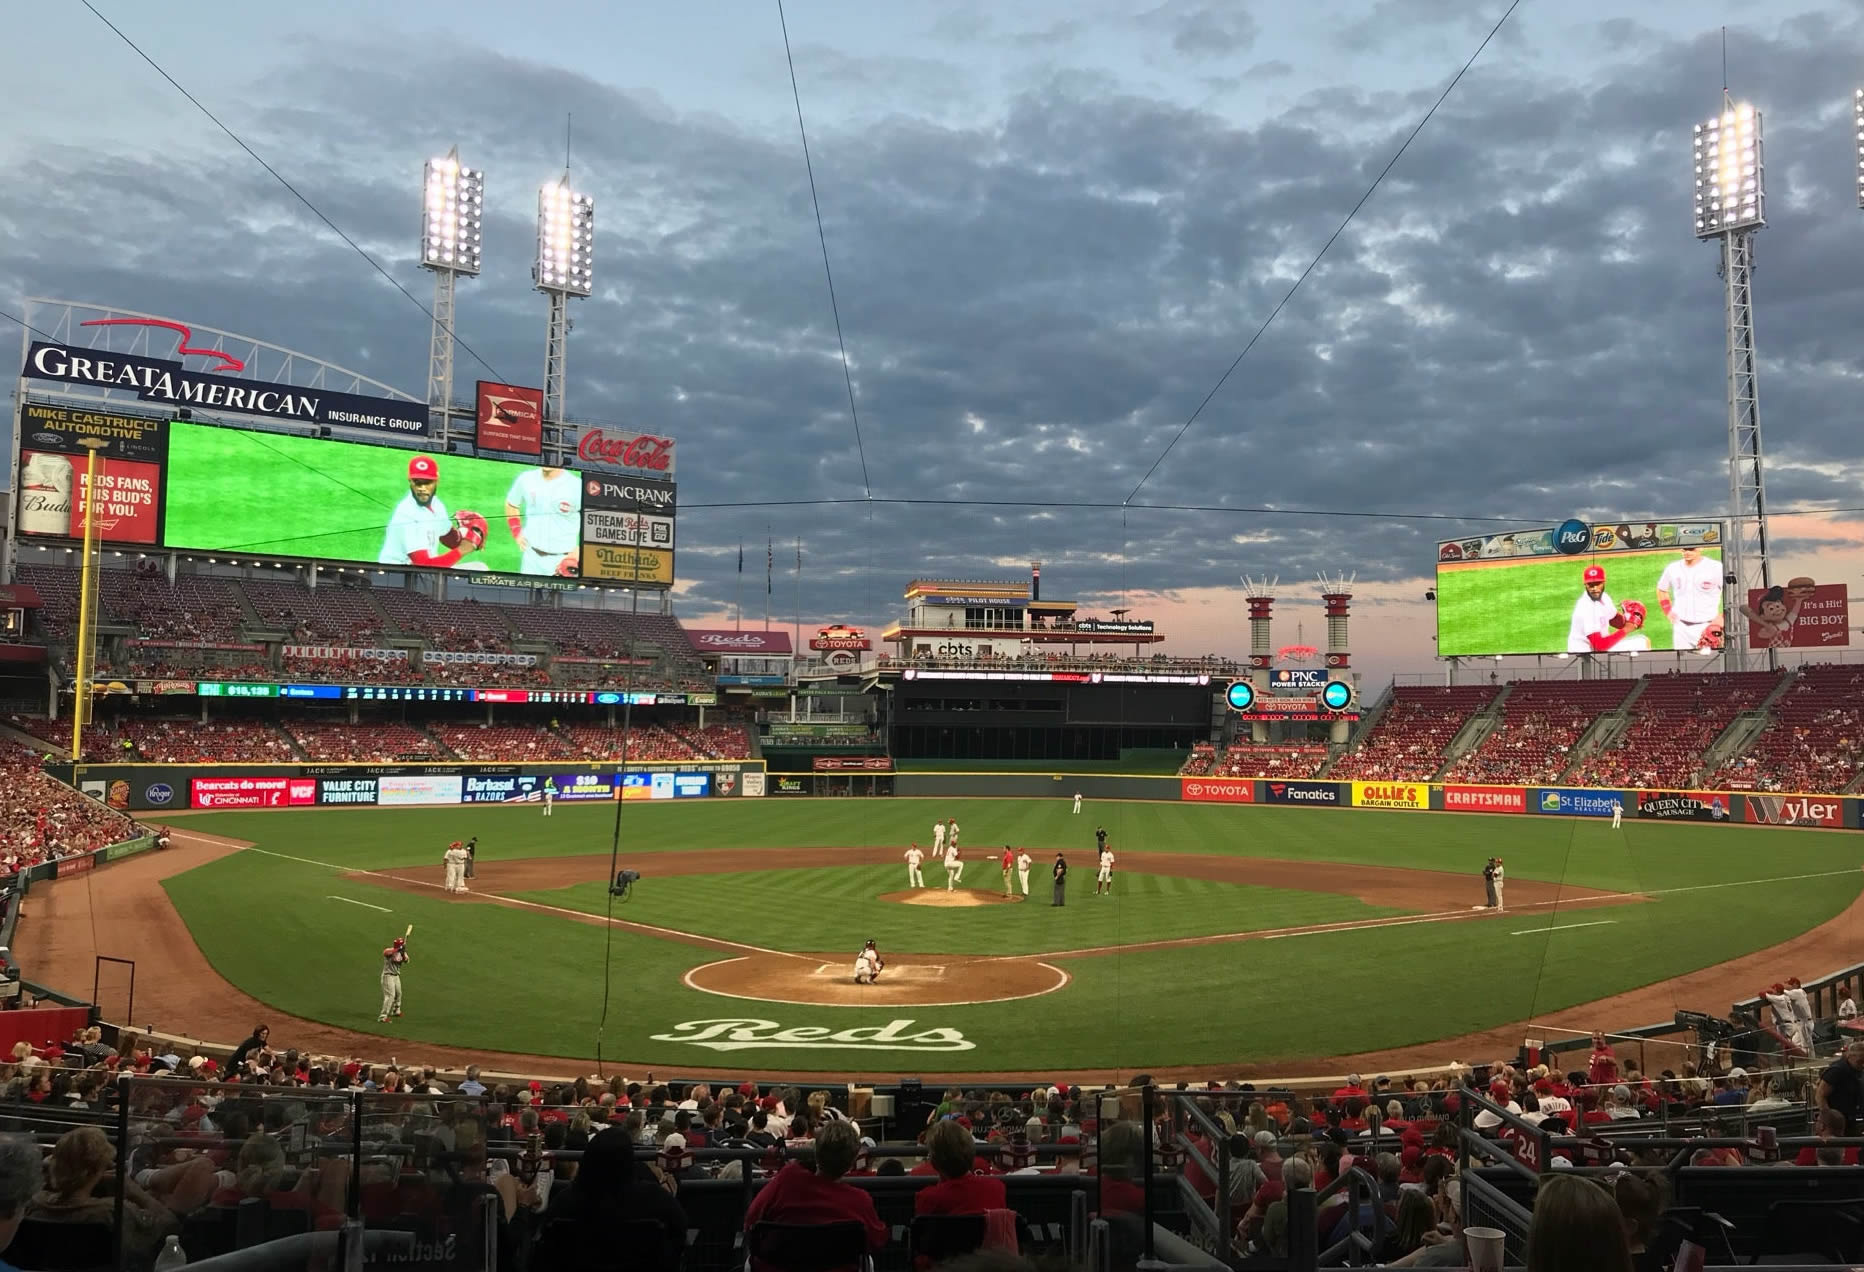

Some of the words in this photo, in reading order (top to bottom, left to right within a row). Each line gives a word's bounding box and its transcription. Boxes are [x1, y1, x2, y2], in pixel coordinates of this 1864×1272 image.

[147, 371, 320, 418] AMERICAN
[28, 407, 67, 421] MIKE
[72, 412, 159, 432] CASTRUCCI
[328, 410, 386, 427] INSURANCE
[389, 418, 423, 431] GROUP
[44, 420, 143, 440] AUTOMOTIVE
[578, 428, 676, 471] Coca-Cola
[117, 475, 153, 493] FANS,
[79, 486, 110, 501] TIS
[112, 490, 152, 505] BUD'S
[108, 503, 138, 518] YOU.
[587, 513, 624, 529] STREAM
[595, 527, 627, 541] GAMES
[1561, 530, 1586, 544] P&G
[1594, 530, 1614, 546] Tide
[472, 577, 515, 587] ULTIMATE
[516, 580, 531, 588] AIR
[534, 581, 576, 591] SHUTTLE
[1804, 601, 1817, 610] It's
[1826, 600, 1843, 609] Hit!
[1800, 616, 1819, 626] BIG
[1821, 614, 1845, 625] BOY
[700, 634, 766, 646] Reds
[829, 640, 864, 648] TOYOTA
[938, 641, 973, 656] cbts
[1291, 671, 1319, 682] PNC
[1277, 703, 1308, 711] TOYOTA
[196, 781, 239, 790] Bearcats
[240, 780, 254, 790] do
[256, 780, 286, 790] more!
[322, 780, 352, 792] VALUE
[354, 780, 376, 791] CITY
[466, 777, 515, 792] Barbasol
[1204, 785, 1249, 796] TOYOTA
[149, 787, 171, 802] Kroger
[290, 786, 314, 798] VCF
[322, 791, 376, 803] FURNITURE
[475, 792, 506, 801] RAZORS
[1287, 787, 1335, 800] Fanatics
[1446, 792, 1521, 806] CRAFTSMAN
[215, 796, 260, 804] CINCINNATI
[1561, 796, 1573, 806] St
[1574, 797, 1621, 808] Elizabeth
[1643, 799, 1679, 813] QUEEN
[1681, 798, 1705, 810] CITY
[1656, 808, 1695, 817] SAUSAGE
[649, 1018, 976, 1052] Reds
[1518, 1136, 1537, 1165] 24
